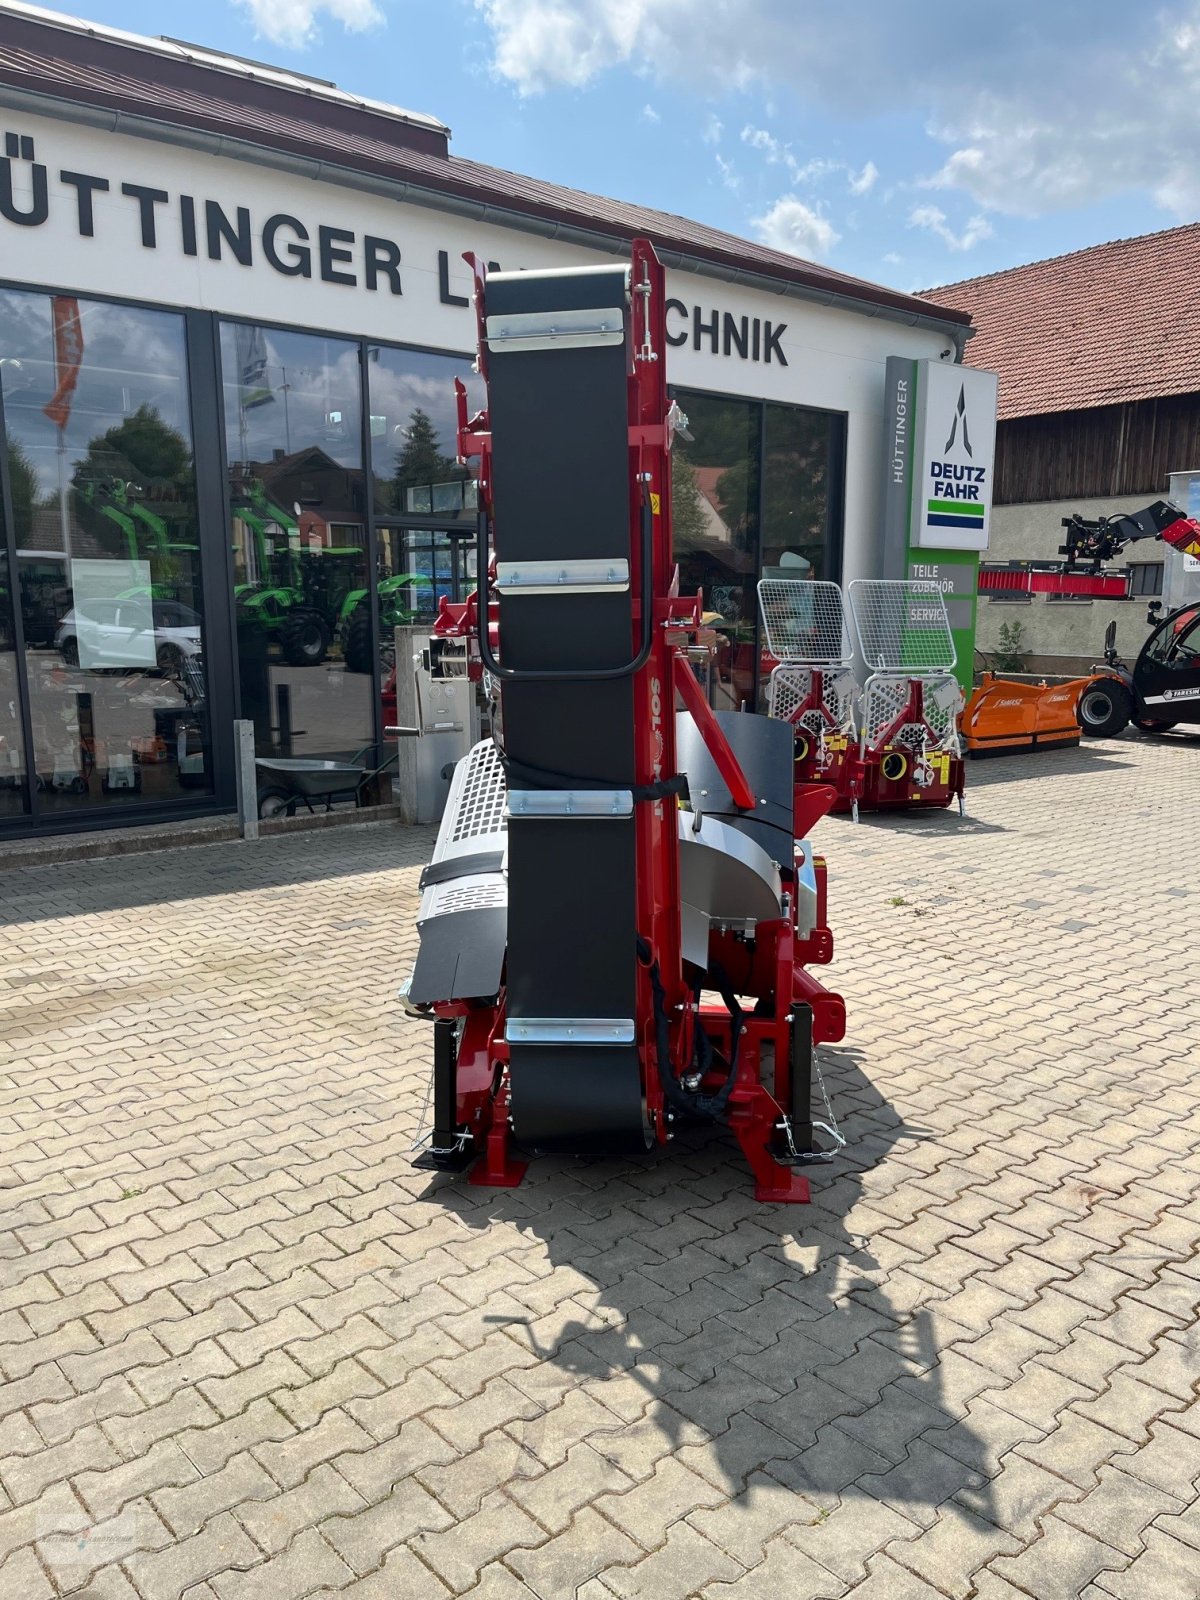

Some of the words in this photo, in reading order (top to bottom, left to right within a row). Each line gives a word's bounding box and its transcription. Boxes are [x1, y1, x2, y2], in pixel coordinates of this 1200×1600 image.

[0, 131, 402, 295] ÜTTINGER
[892, 379, 908, 483] HÜTTINGER
[930, 461, 986, 483] DEUTZ
[934, 481, 979, 500] FAHR
[913, 564, 939, 578] TEILE
